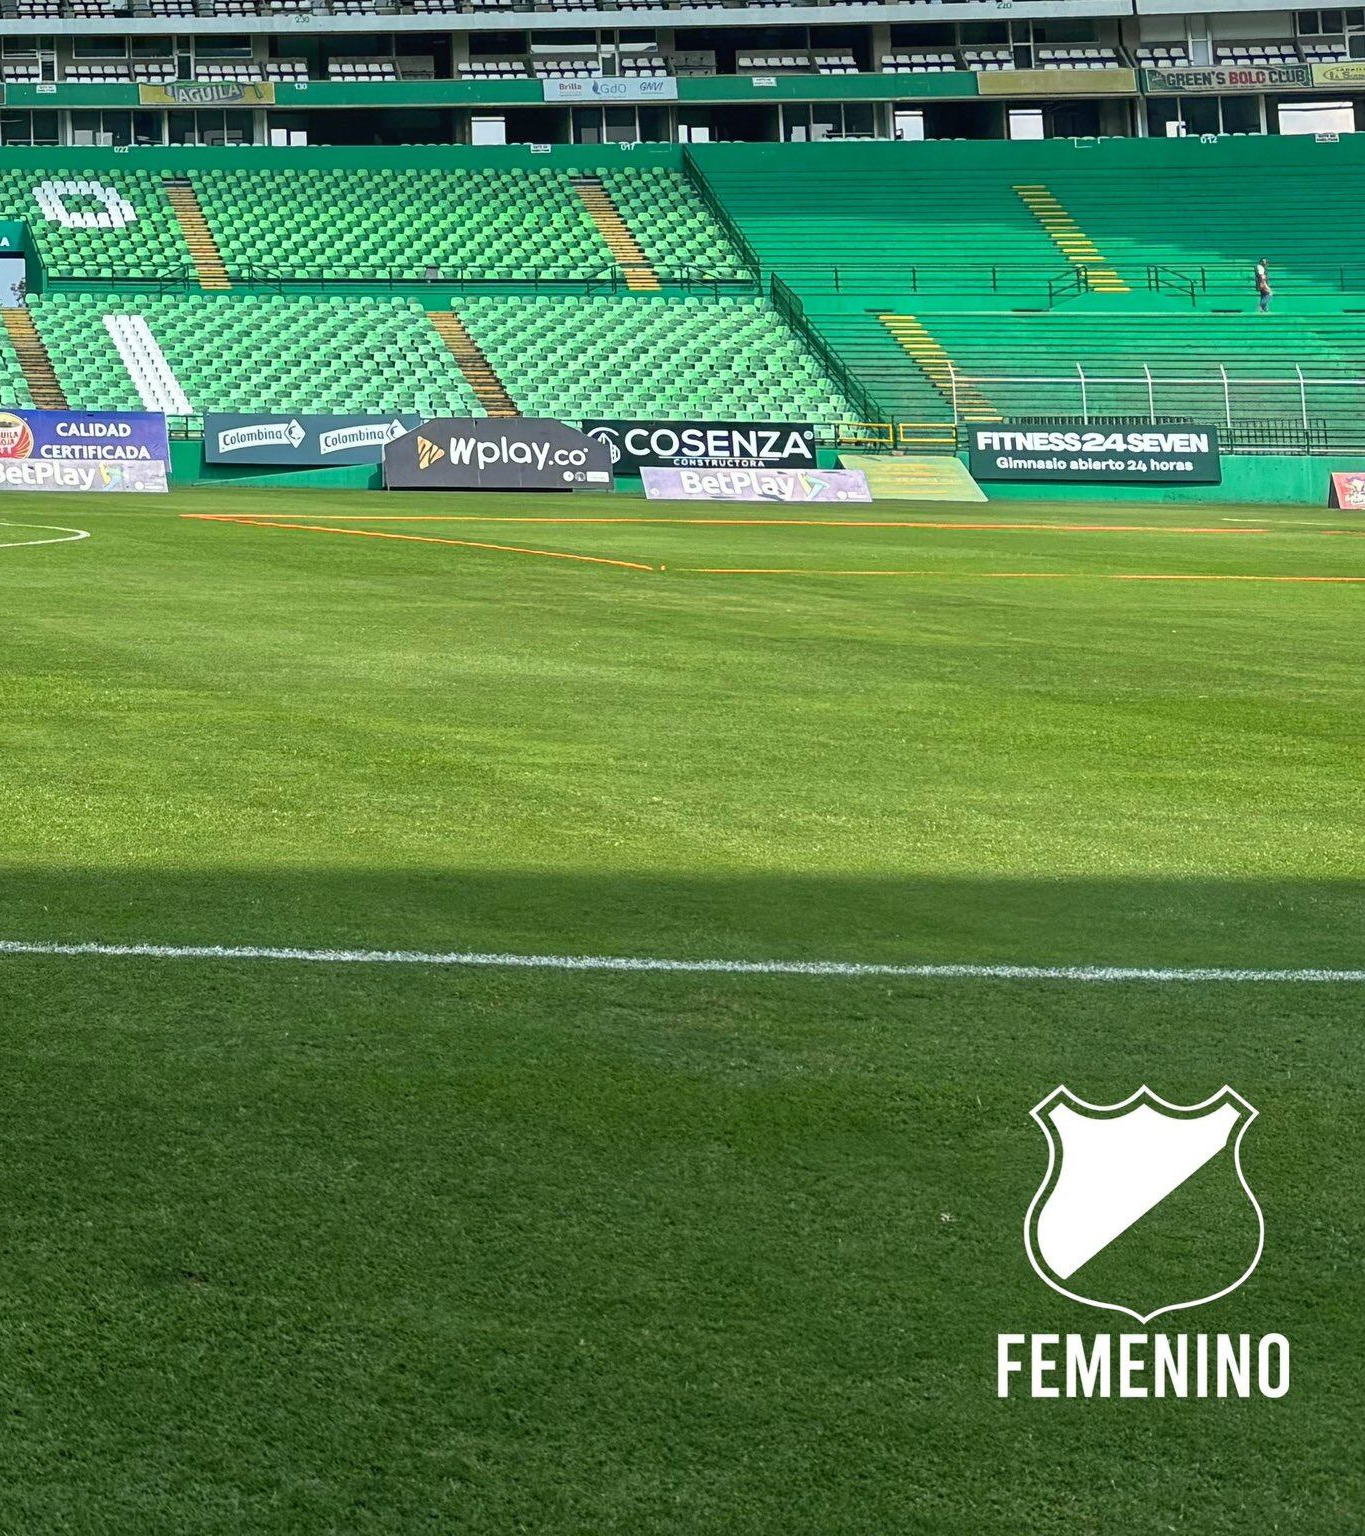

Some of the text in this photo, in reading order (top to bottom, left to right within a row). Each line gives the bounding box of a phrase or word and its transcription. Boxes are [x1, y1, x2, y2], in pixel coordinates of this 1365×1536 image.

[1169, 71, 1225, 86] GREEN'S
[1269, 70, 1305, 84] CLUB
[179, 84, 241, 103] AGUILA
[55, 422, 132, 438] CALIDAD
[223, 428, 283, 446] Colombina
[324, 428, 385, 448] Colombina
[625, 428, 813, 459] COSENZA
[977, 432, 1209, 452] FITNESS24SEVEN
[40, 444, 151, 460] CERTIFICADA
[673, 459, 765, 468] CONSTRUCTORA
[996, 456, 1193, 472] Gimnasio abierto 24 horas
[679, 471, 795, 500] BetPlay
